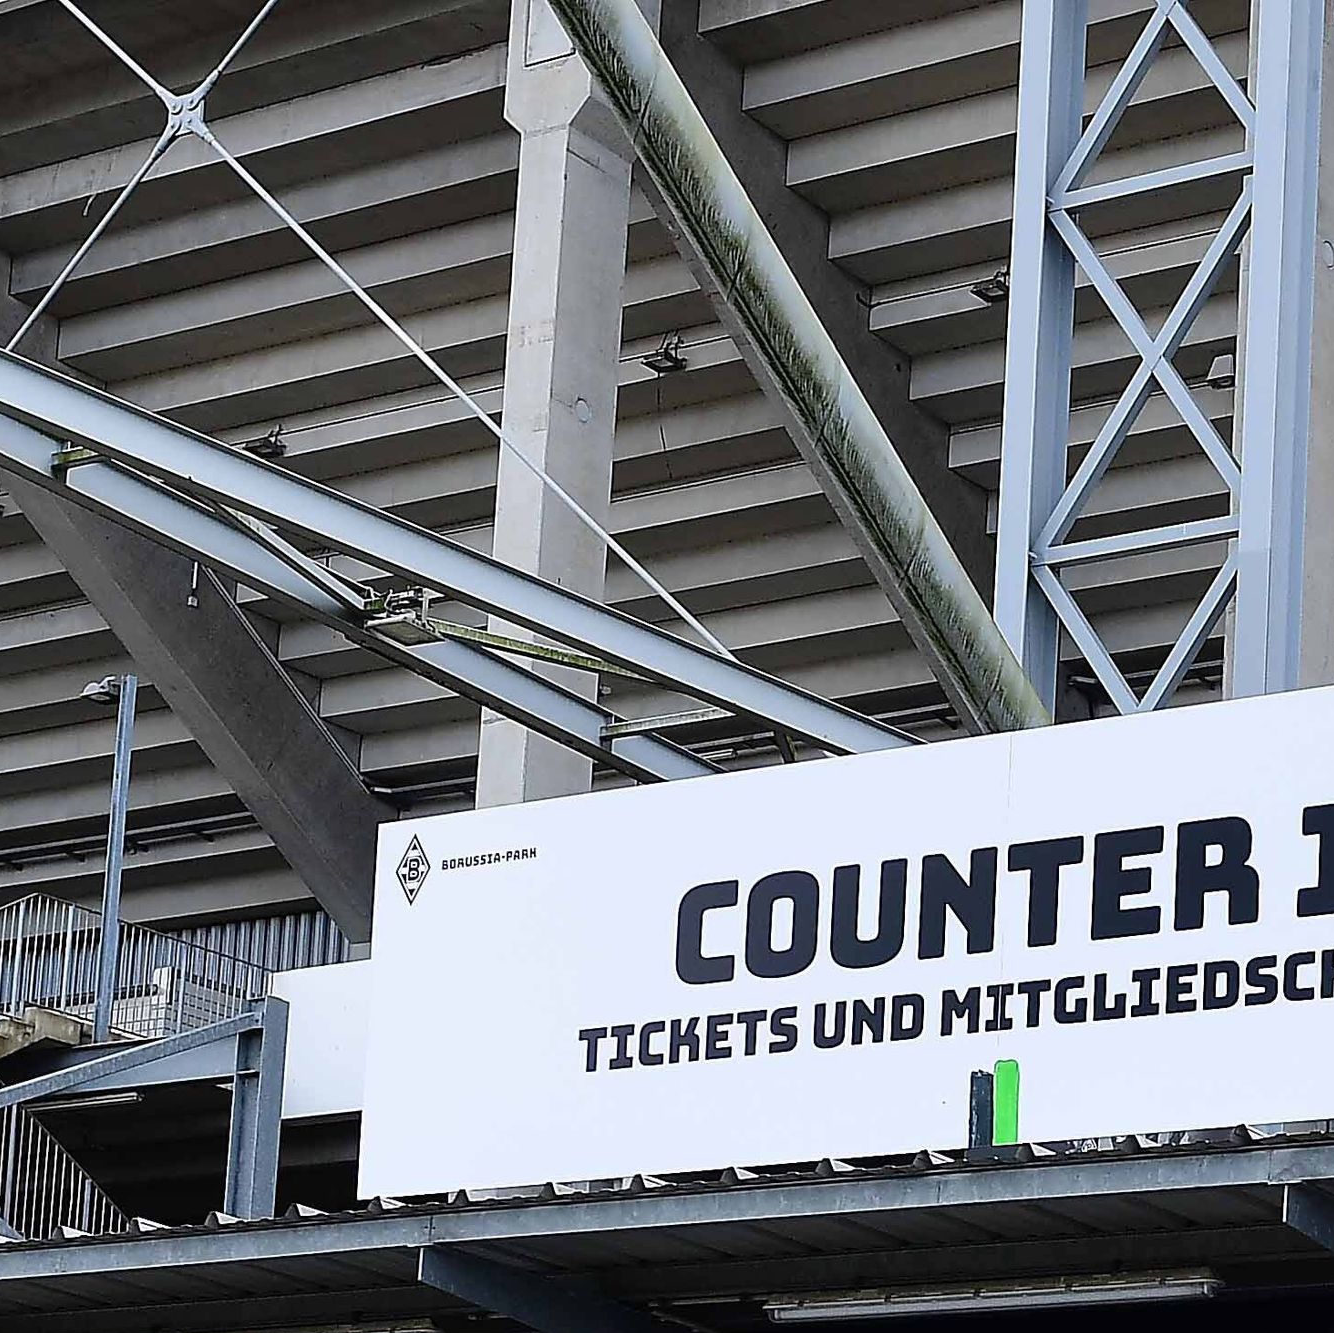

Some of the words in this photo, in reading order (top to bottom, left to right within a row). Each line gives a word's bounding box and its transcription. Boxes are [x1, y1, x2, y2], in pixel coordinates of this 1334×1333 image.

[441, 847, 537, 870] BORUSSIA-PARK
[675, 815, 1260, 985] COUNTER
[578, 1006, 798, 1072] TICKETS
[813, 993, 925, 1049] UND
